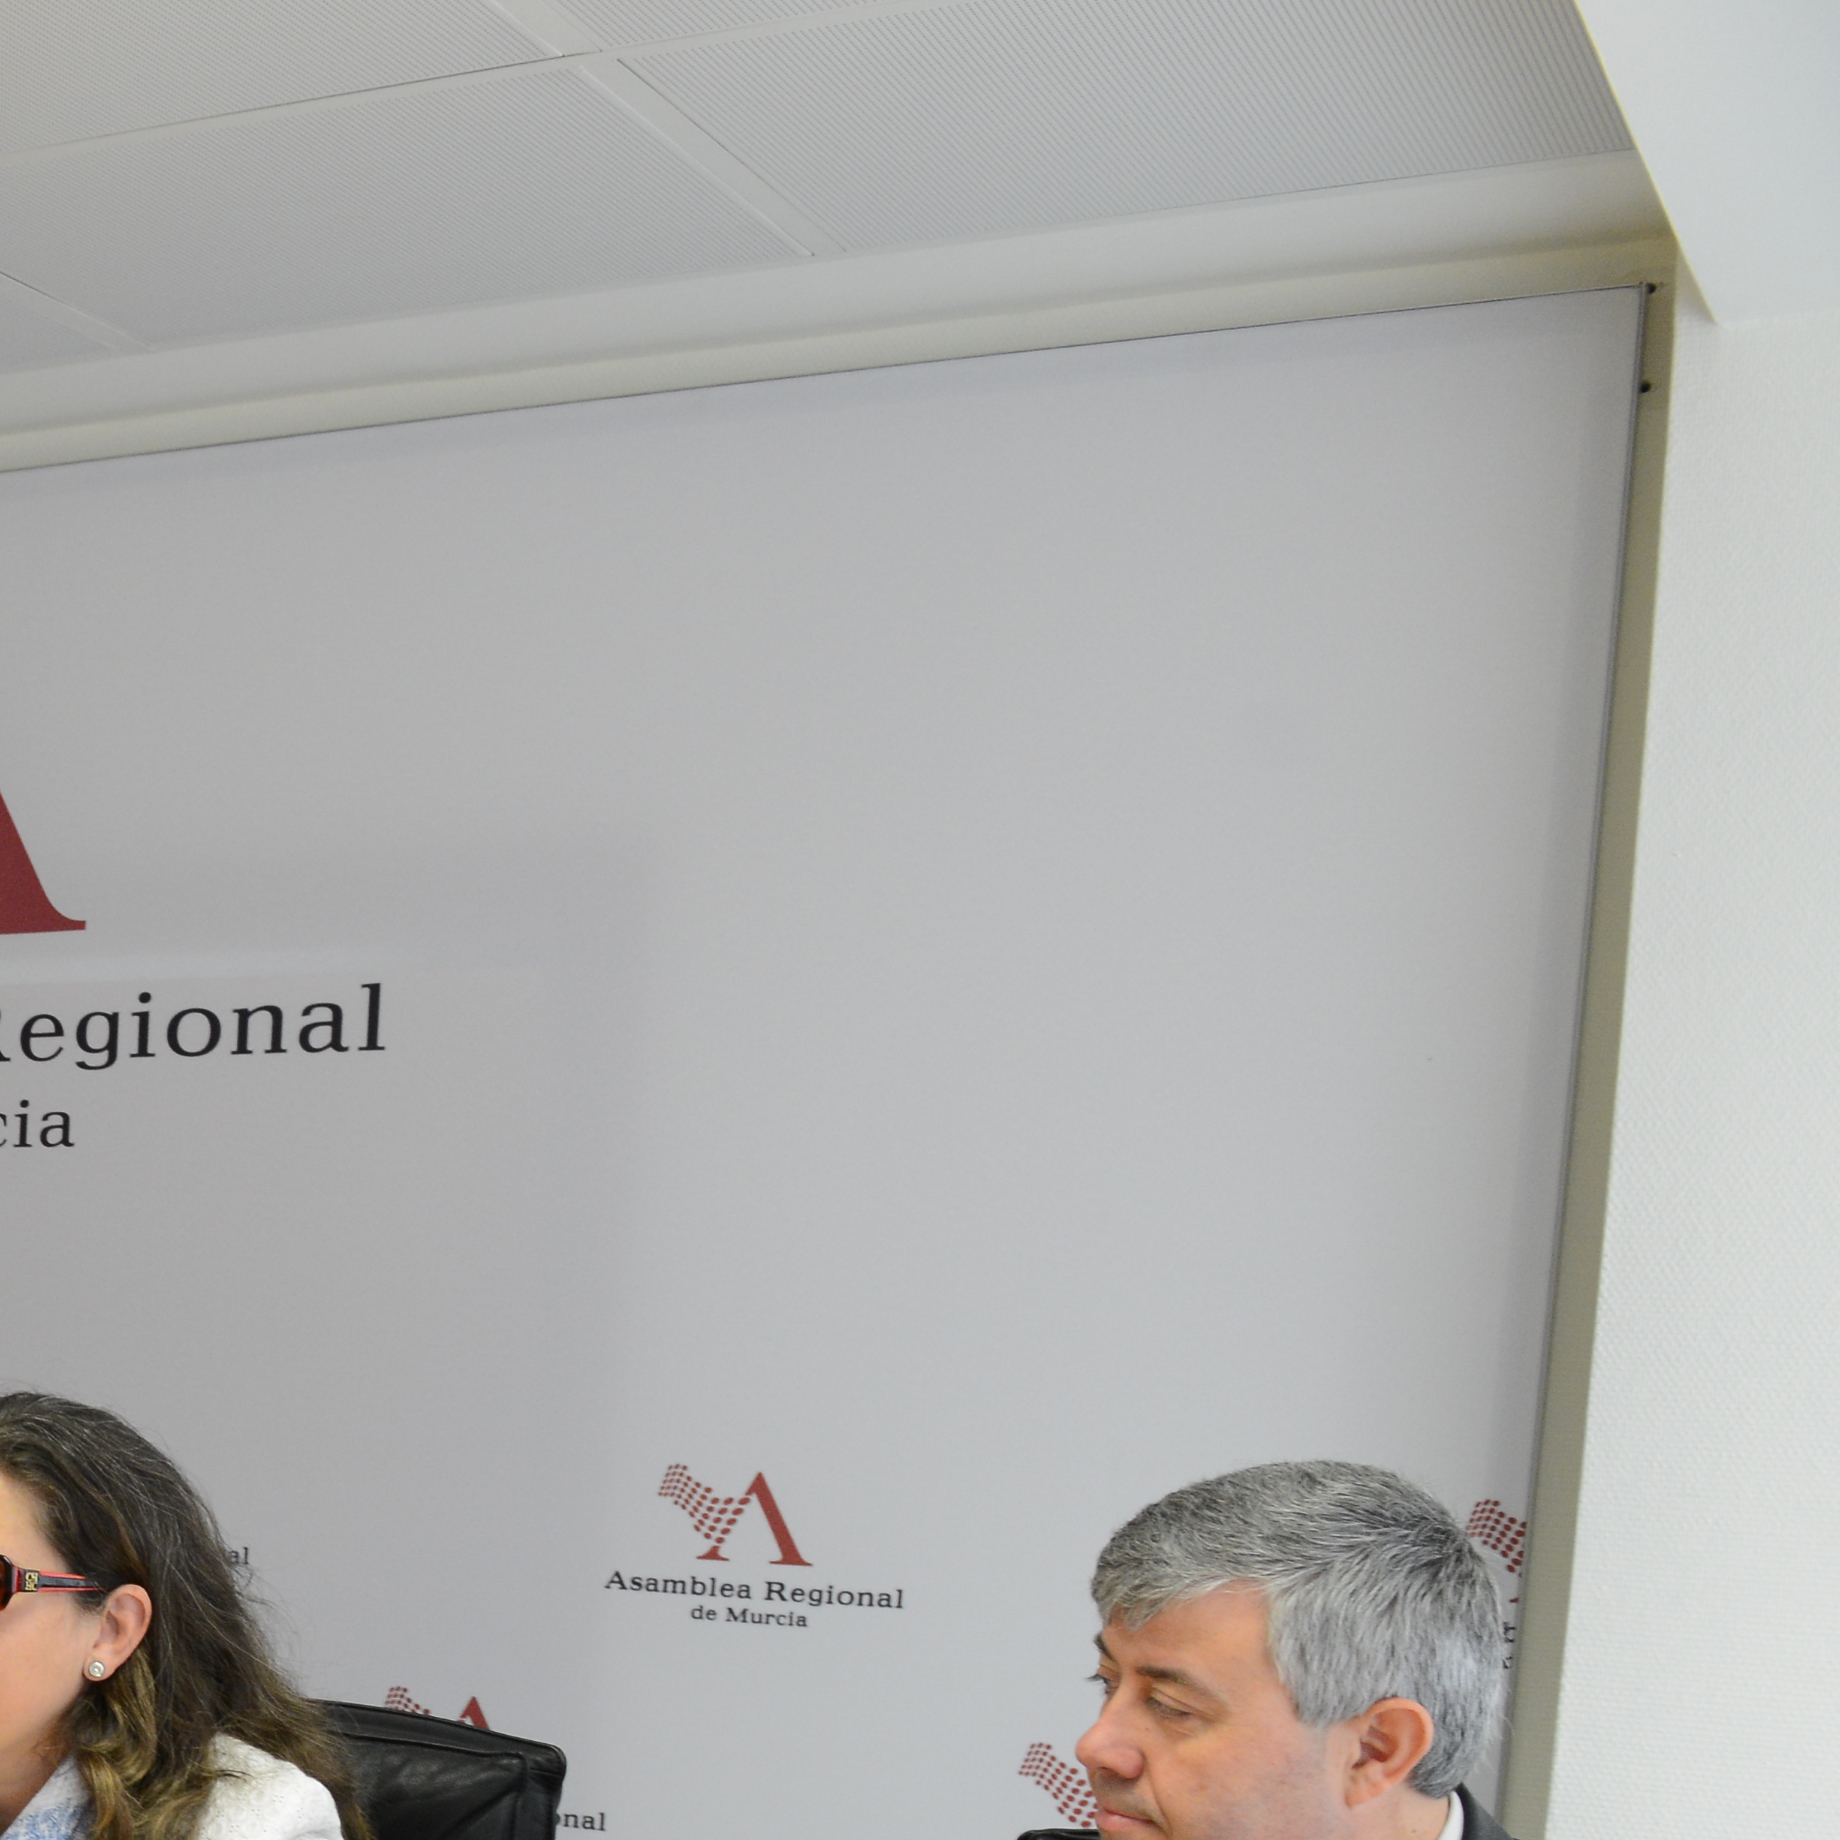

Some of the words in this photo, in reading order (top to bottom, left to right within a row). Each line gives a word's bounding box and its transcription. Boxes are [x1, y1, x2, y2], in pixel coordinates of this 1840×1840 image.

[604, 1570, 753, 1599] Asamblea
[764, 1581, 905, 1609] Regional
[690, 1605, 718, 1621] de
[725, 1607, 809, 1628] Murcia
